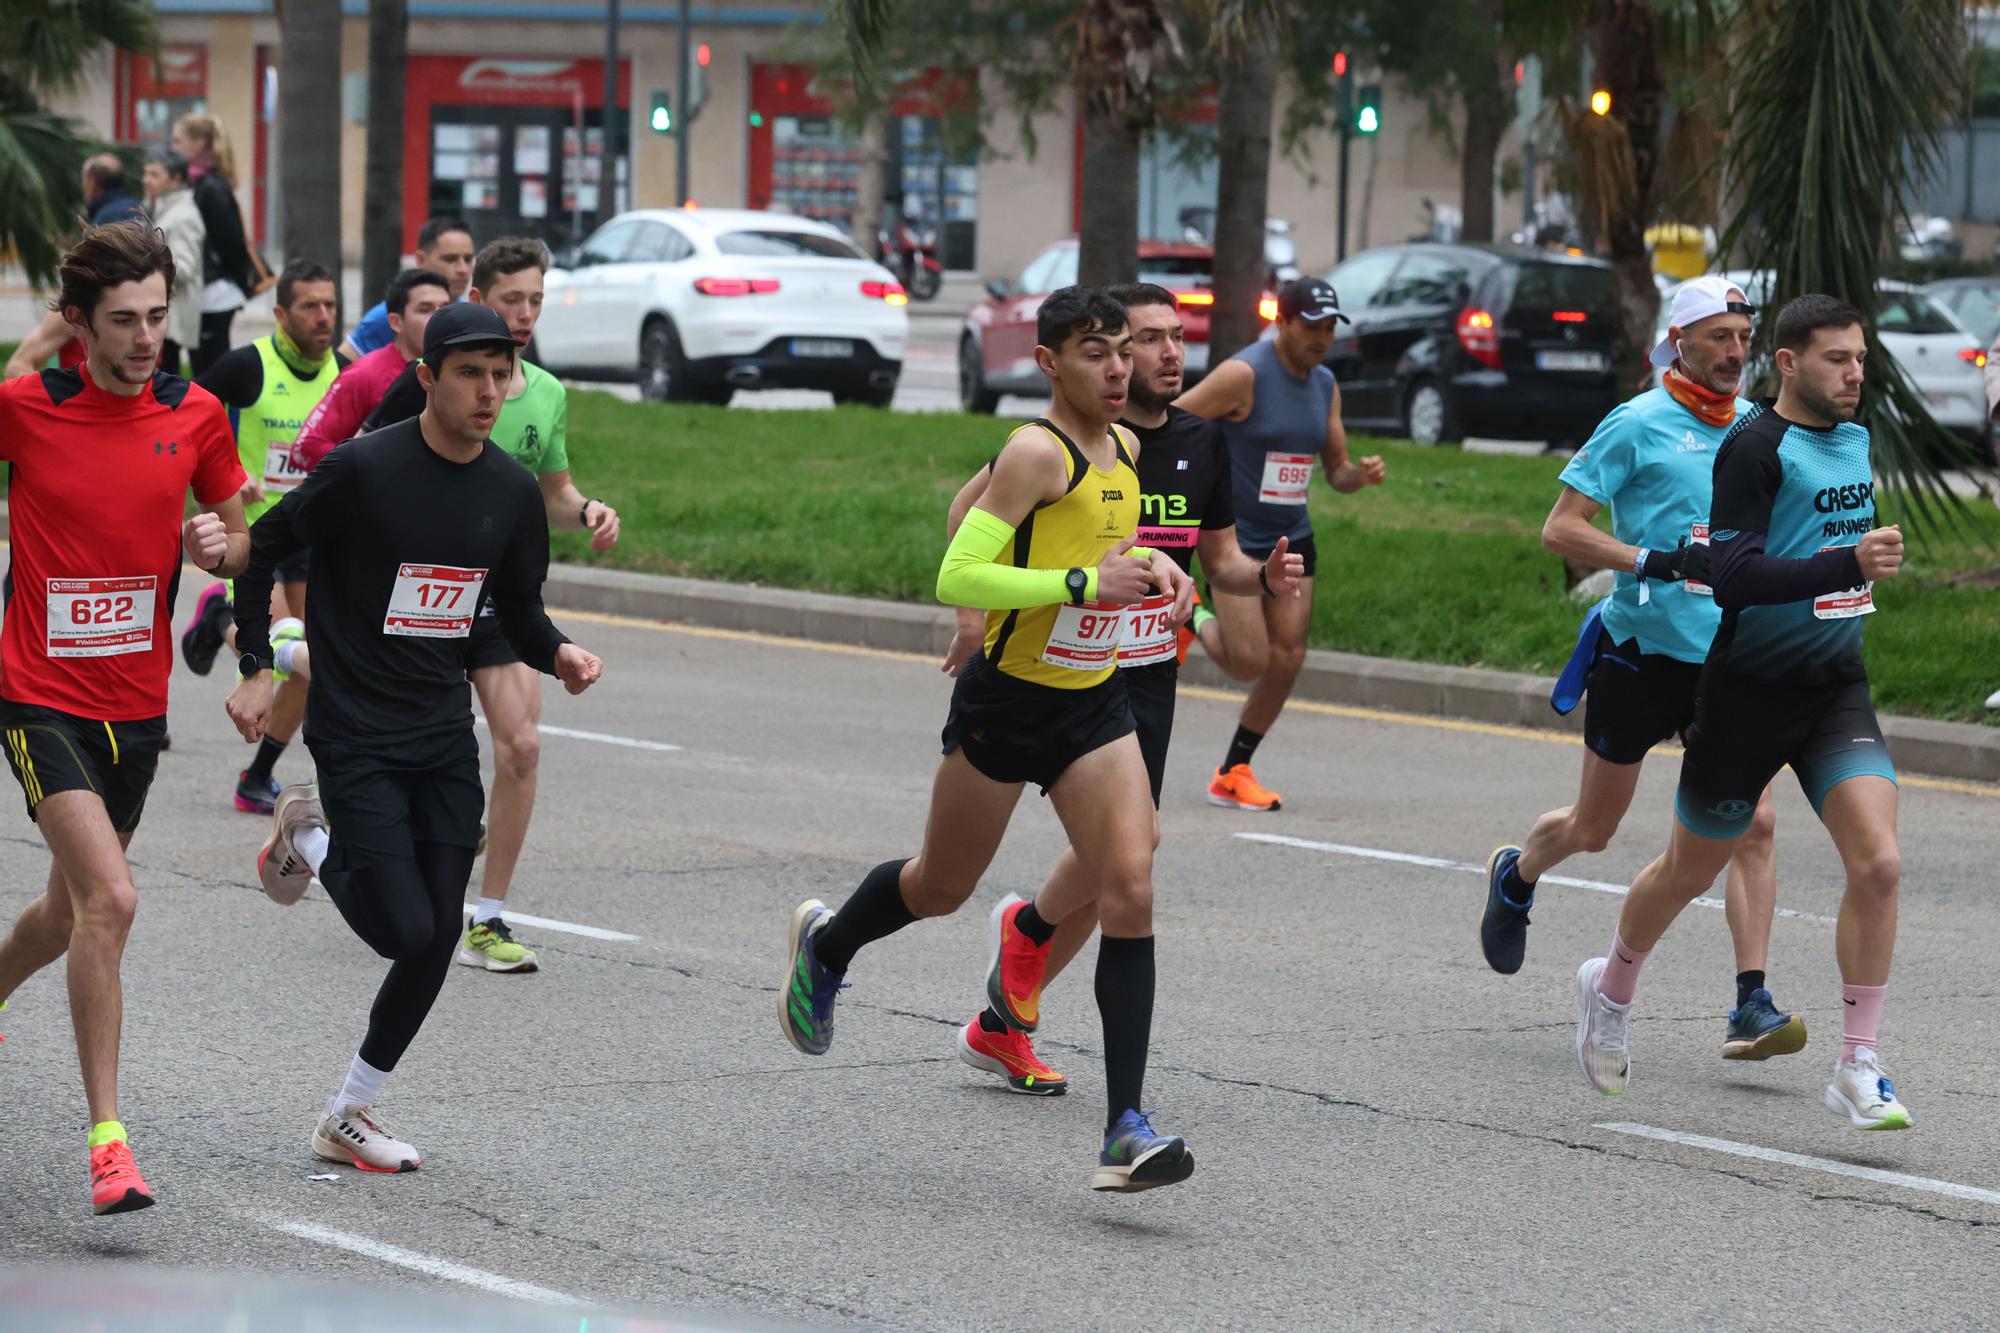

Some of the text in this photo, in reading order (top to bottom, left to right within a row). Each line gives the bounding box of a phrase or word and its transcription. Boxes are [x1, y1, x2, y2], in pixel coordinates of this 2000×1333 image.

[1279, 467, 1308, 484] 695
[417, 583, 464, 609] 177
[71, 596, 133, 625] 622
[1077, 614, 1120, 640] 977
[1129, 611, 1170, 638] 179
